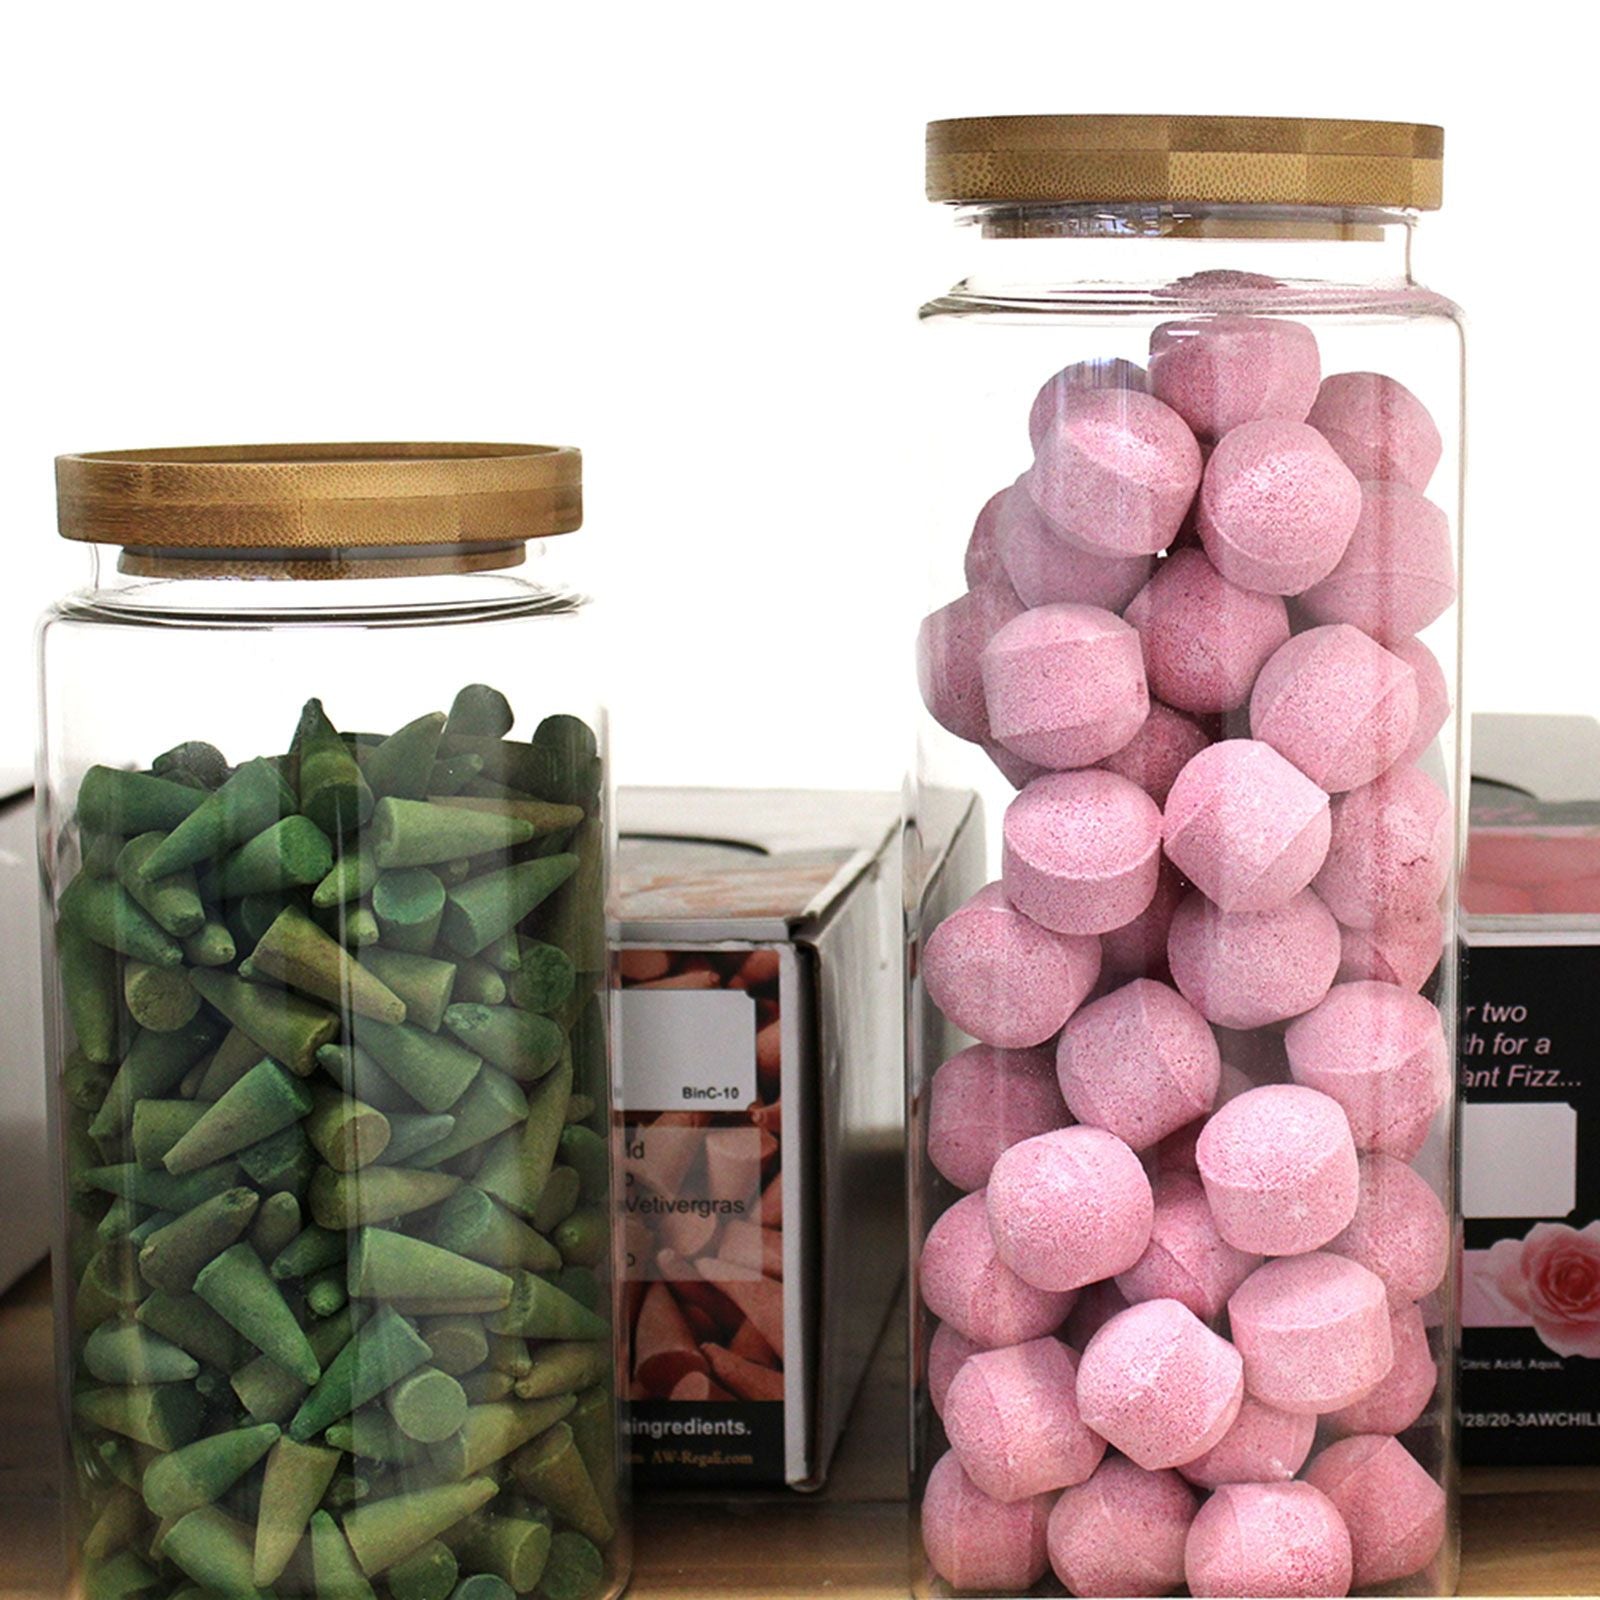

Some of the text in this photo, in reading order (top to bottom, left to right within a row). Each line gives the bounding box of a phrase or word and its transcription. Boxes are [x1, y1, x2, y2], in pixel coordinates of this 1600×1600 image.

[1481, 1002, 1527, 1023] two
[1492, 1032, 1528, 1055] for
[1534, 1037, 1552, 1055] a
[1506, 1064, 1582, 1087] Fizz...
[682, 1086, 740, 1100] BinC-10
[625, 1196, 745, 1220] Vetivergras
[632, 1417, 752, 1440] ingredients.
